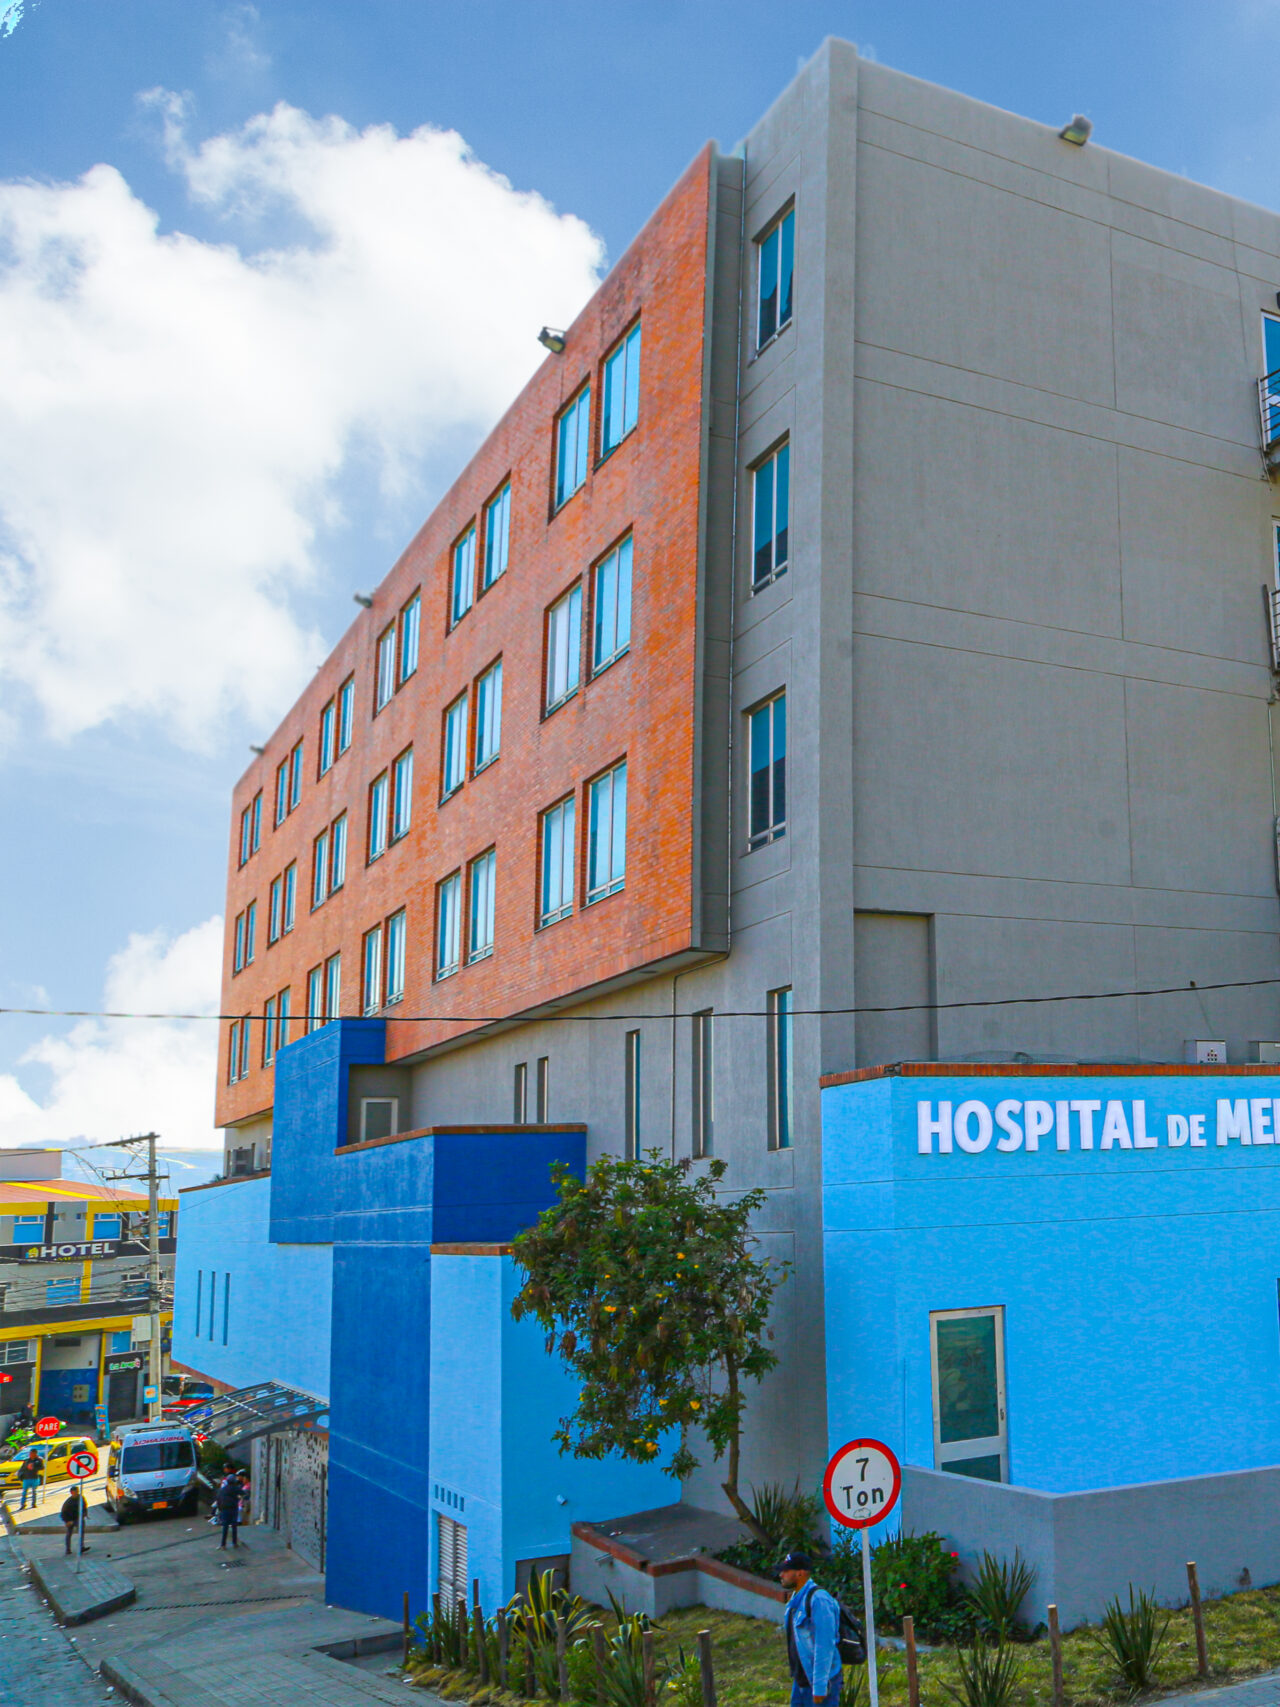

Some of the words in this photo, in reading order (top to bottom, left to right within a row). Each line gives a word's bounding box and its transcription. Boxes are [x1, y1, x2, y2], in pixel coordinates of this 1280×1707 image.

[917, 1099, 1158, 1154] HOSPITAL
[1167, 1114, 1207, 1147] DE
[40, 1242, 115, 1258] HOTEL
[39, 1422, 59, 1431] PARE
[856, 1457, 869, 1482] 7
[843, 1485, 884, 1509] Ton
